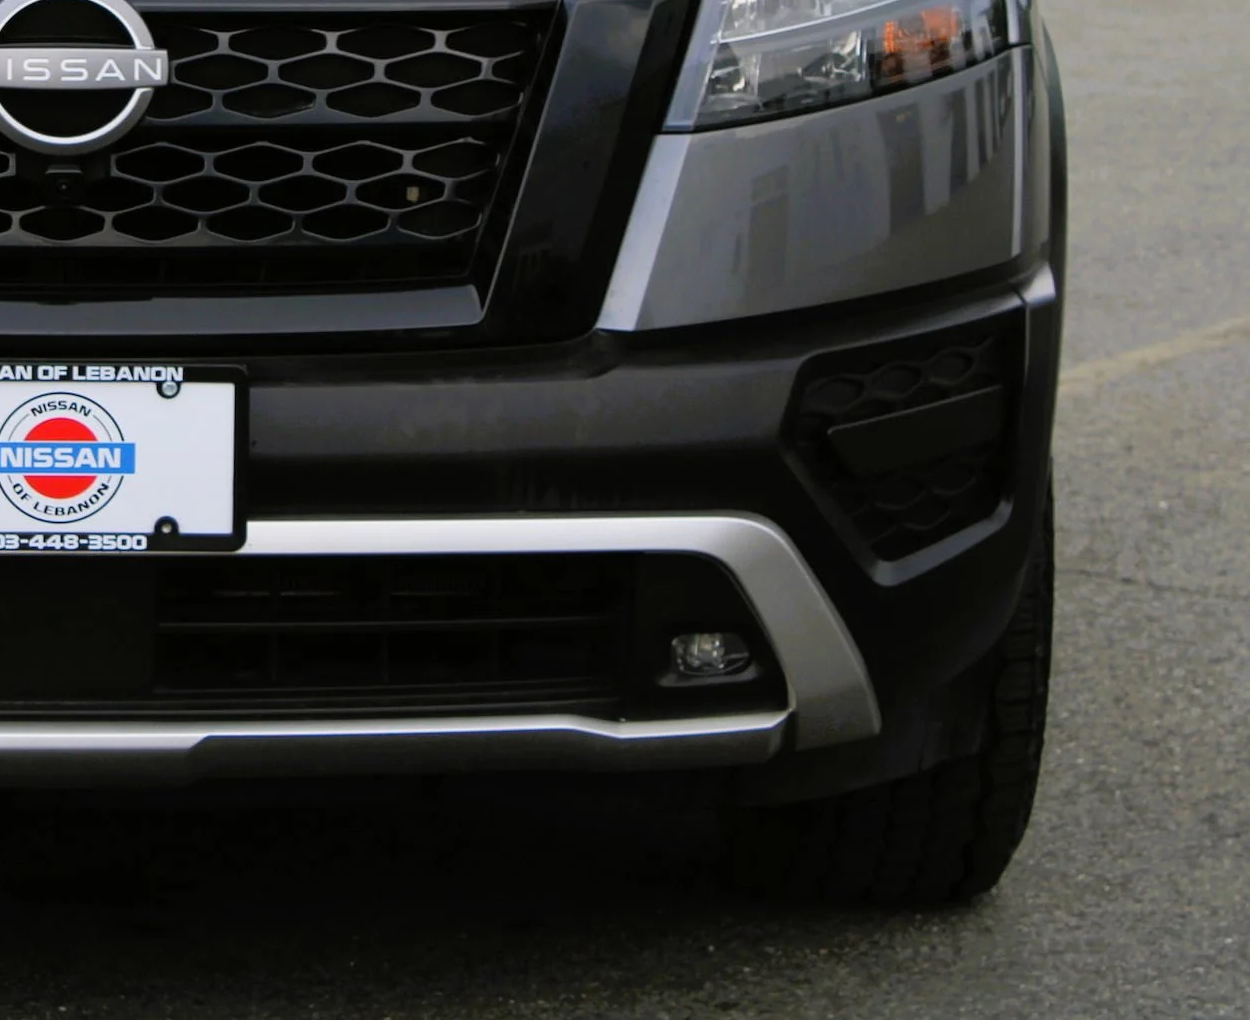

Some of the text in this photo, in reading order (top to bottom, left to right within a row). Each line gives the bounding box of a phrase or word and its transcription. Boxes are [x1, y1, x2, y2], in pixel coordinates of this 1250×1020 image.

[37, 366, 68, 380] OF
[72, 366, 184, 381] LEBANON
[30, 400, 92, 417] NISSAN
[0, 447, 121, 468] NISSAN
[12, 482, 110, 517] OF LEBANON
